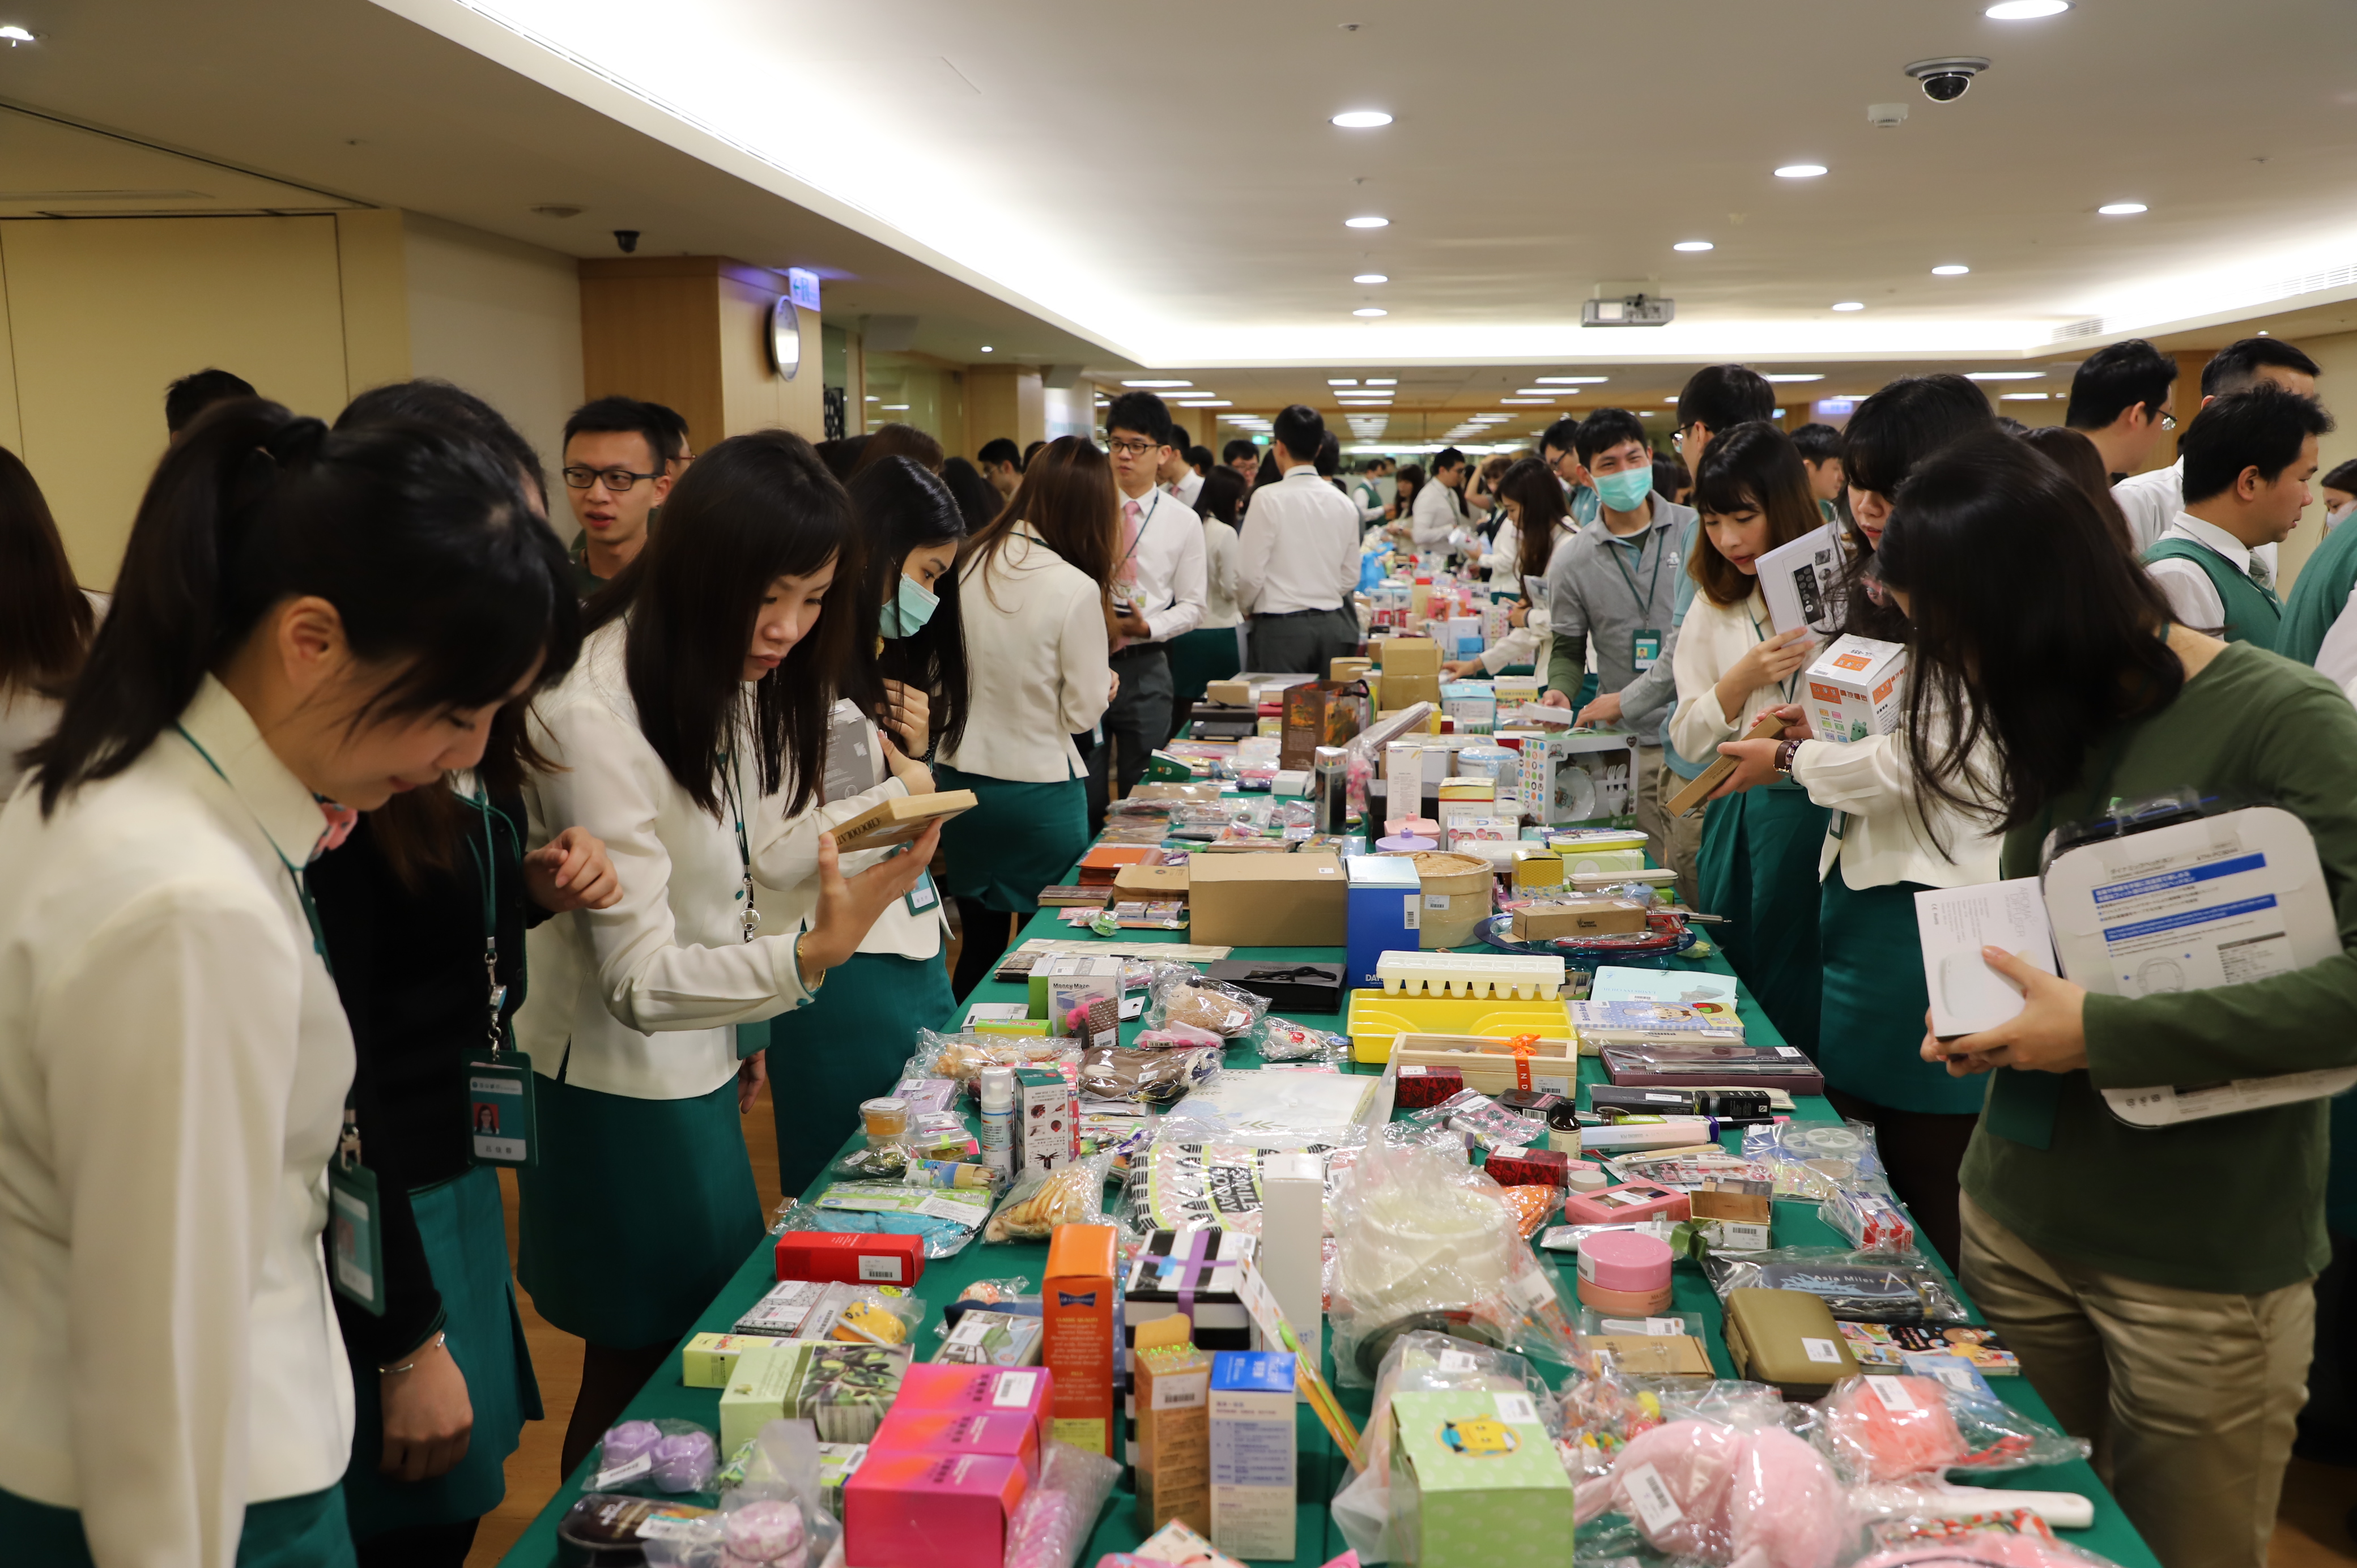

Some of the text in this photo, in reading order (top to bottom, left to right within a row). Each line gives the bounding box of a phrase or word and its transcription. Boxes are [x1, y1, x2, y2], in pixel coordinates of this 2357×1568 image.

[1724, 761, 1734, 770] GREEN
[836, 817, 880, 846] CHOCOOLAT
[2010, 893, 2026, 938] DIFFUSER
[2017, 886, 2033, 921] AROMA
[1212, 1168, 1240, 1212] TODAY
[1233, 1170, 1259, 1211] SMILE
[1844, 1275, 1875, 1284] Miles
